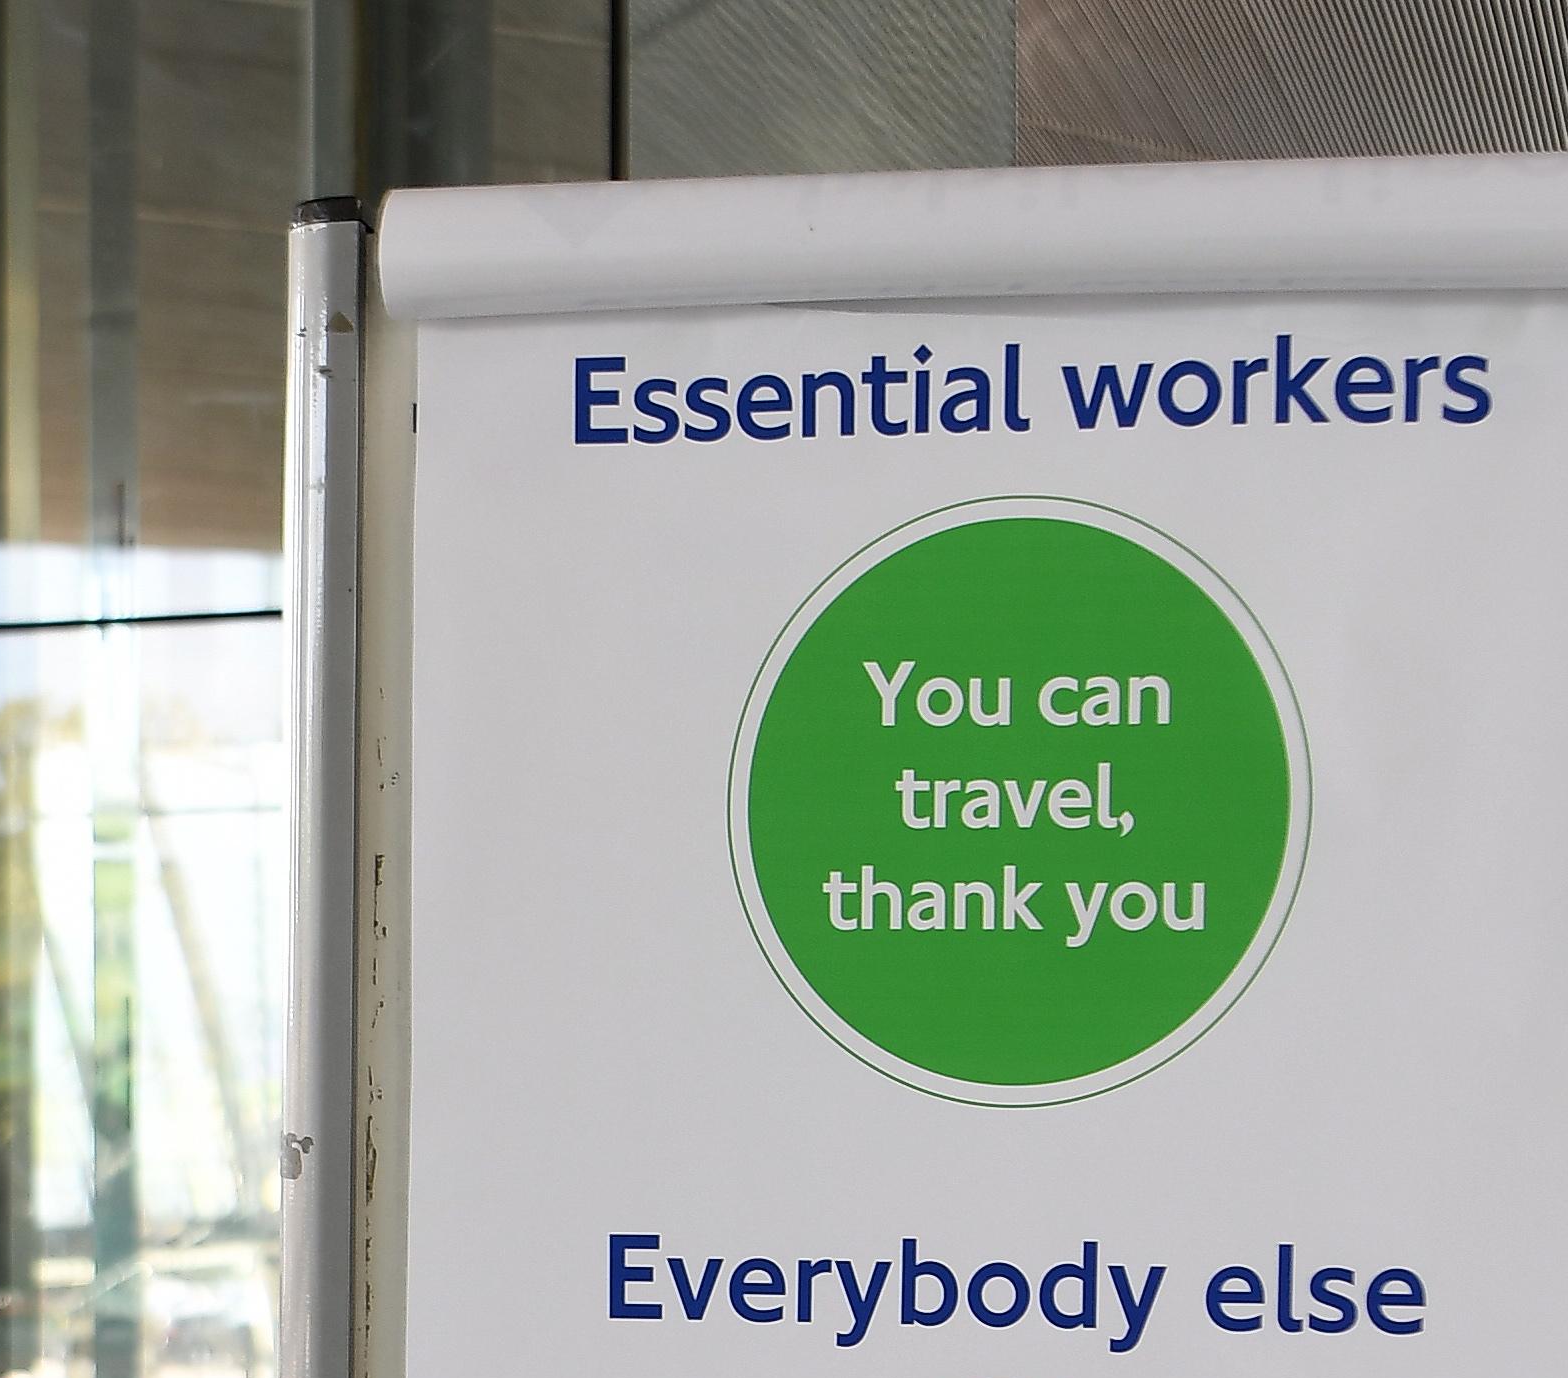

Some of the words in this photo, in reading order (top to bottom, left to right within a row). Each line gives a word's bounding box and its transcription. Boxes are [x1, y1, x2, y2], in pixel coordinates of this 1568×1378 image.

[573, 343, 1030, 444] Essential
[1062, 335, 1491, 430] workers
[863, 661, 1012, 727] You
[1038, 671, 1171, 726] can
[895, 762, 1135, 837] travel,
[823, 865, 1044, 932] thank
[1064, 880, 1206, 948] you
[608, 1233, 1166, 1353] Everybody
[1204, 1243, 1426, 1335] else
